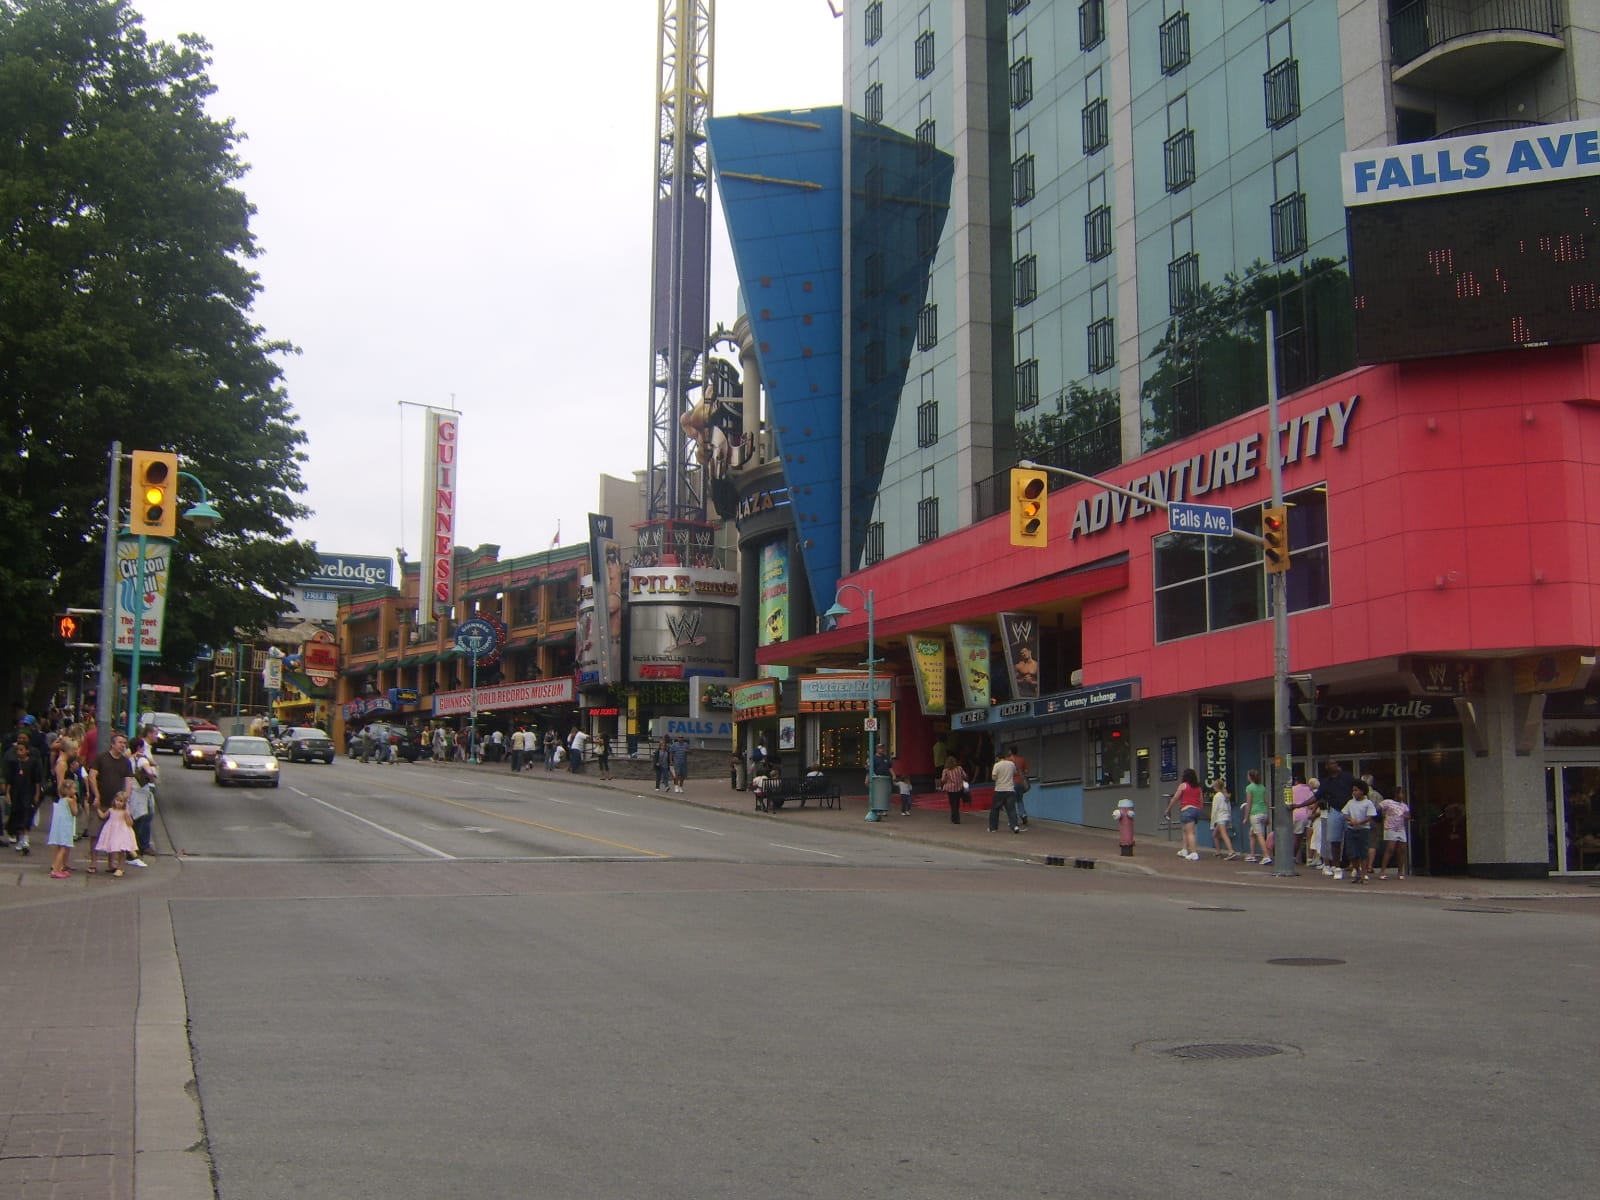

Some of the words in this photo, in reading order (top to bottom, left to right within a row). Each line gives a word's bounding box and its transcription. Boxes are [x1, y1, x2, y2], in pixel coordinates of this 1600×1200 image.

[1354, 144, 1490, 194] FALLS
[1506, 129, 1600, 174] AVE
[1069, 432, 1261, 540] ADVENTURE
[436, 420, 456, 602] GUINNESS
[1172, 507, 1201, 528] Falls
[630, 574, 691, 595] PILE
[439, 694, 471, 710] GUINNESS
[477, 691, 496, 706] ORLD
[498, 687, 530, 703] RECORDS
[531, 683, 564, 699] MUSEUM
[1064, 696, 1088, 708] Currency
[1090, 691, 1116, 703] Exchange
[1326, 704, 1358, 722] On
[1361, 705, 1378, 716] the
[1381, 700, 1432, 719] Falls
[668, 719, 713, 735] FALLS
[1205, 725, 1216, 788] Currency
